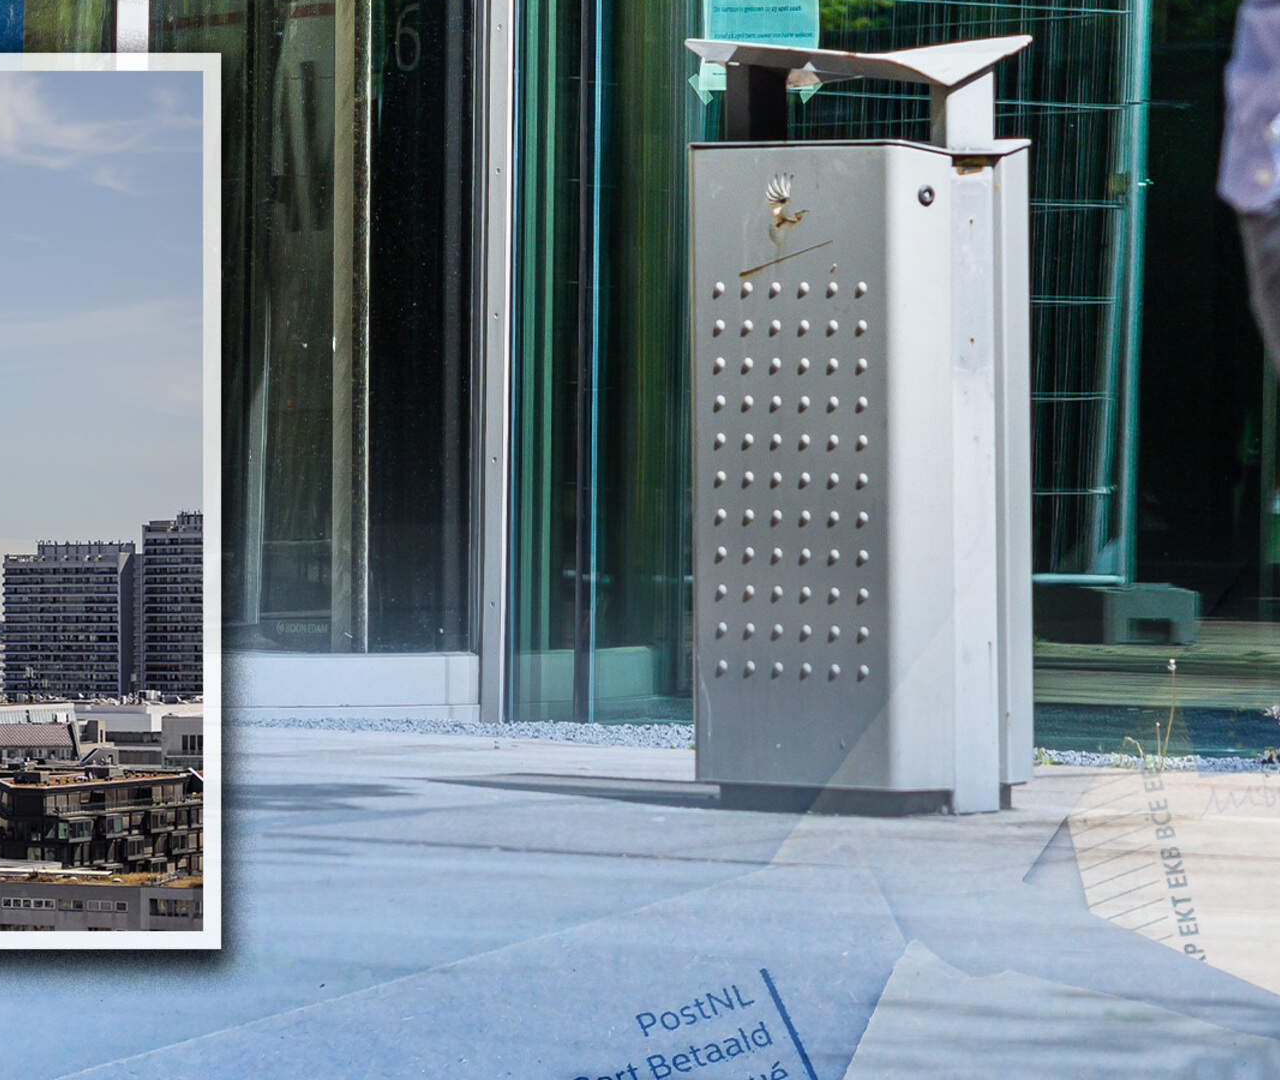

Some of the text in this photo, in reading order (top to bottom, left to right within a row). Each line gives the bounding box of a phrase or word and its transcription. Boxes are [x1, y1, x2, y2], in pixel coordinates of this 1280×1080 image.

[1160, 846, 1189, 890] EKB
[1171, 895, 1200, 938] EKT
[635, 984, 755, 1037] PostNL
[646, 1021, 774, 1080] Betaald
